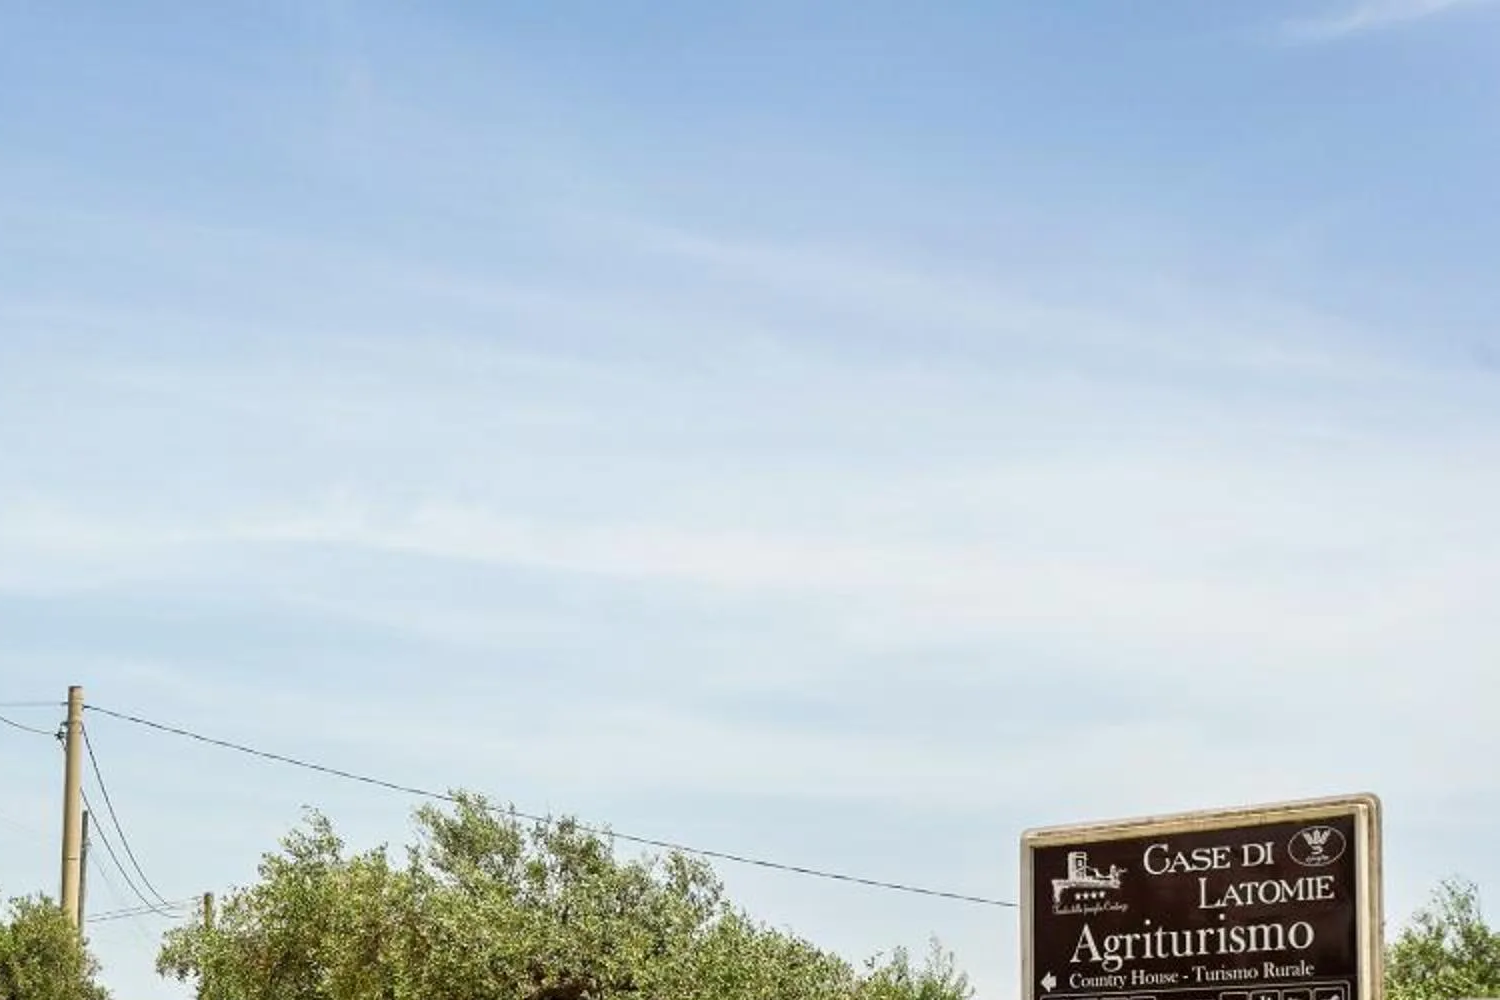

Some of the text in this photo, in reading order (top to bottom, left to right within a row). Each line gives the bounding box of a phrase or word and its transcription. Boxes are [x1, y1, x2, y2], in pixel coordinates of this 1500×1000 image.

[1143, 842, 1275, 875] CASE DI
[1198, 876, 1335, 909] LATOMIE
[1070, 913, 1315, 972] Agriturismo
[1069, 972, 1128, 989] Country
[1131, 969, 1179, 985] House
[1192, 965, 1258, 982] Turismo
[1263, 960, 1315, 978] Rurale
